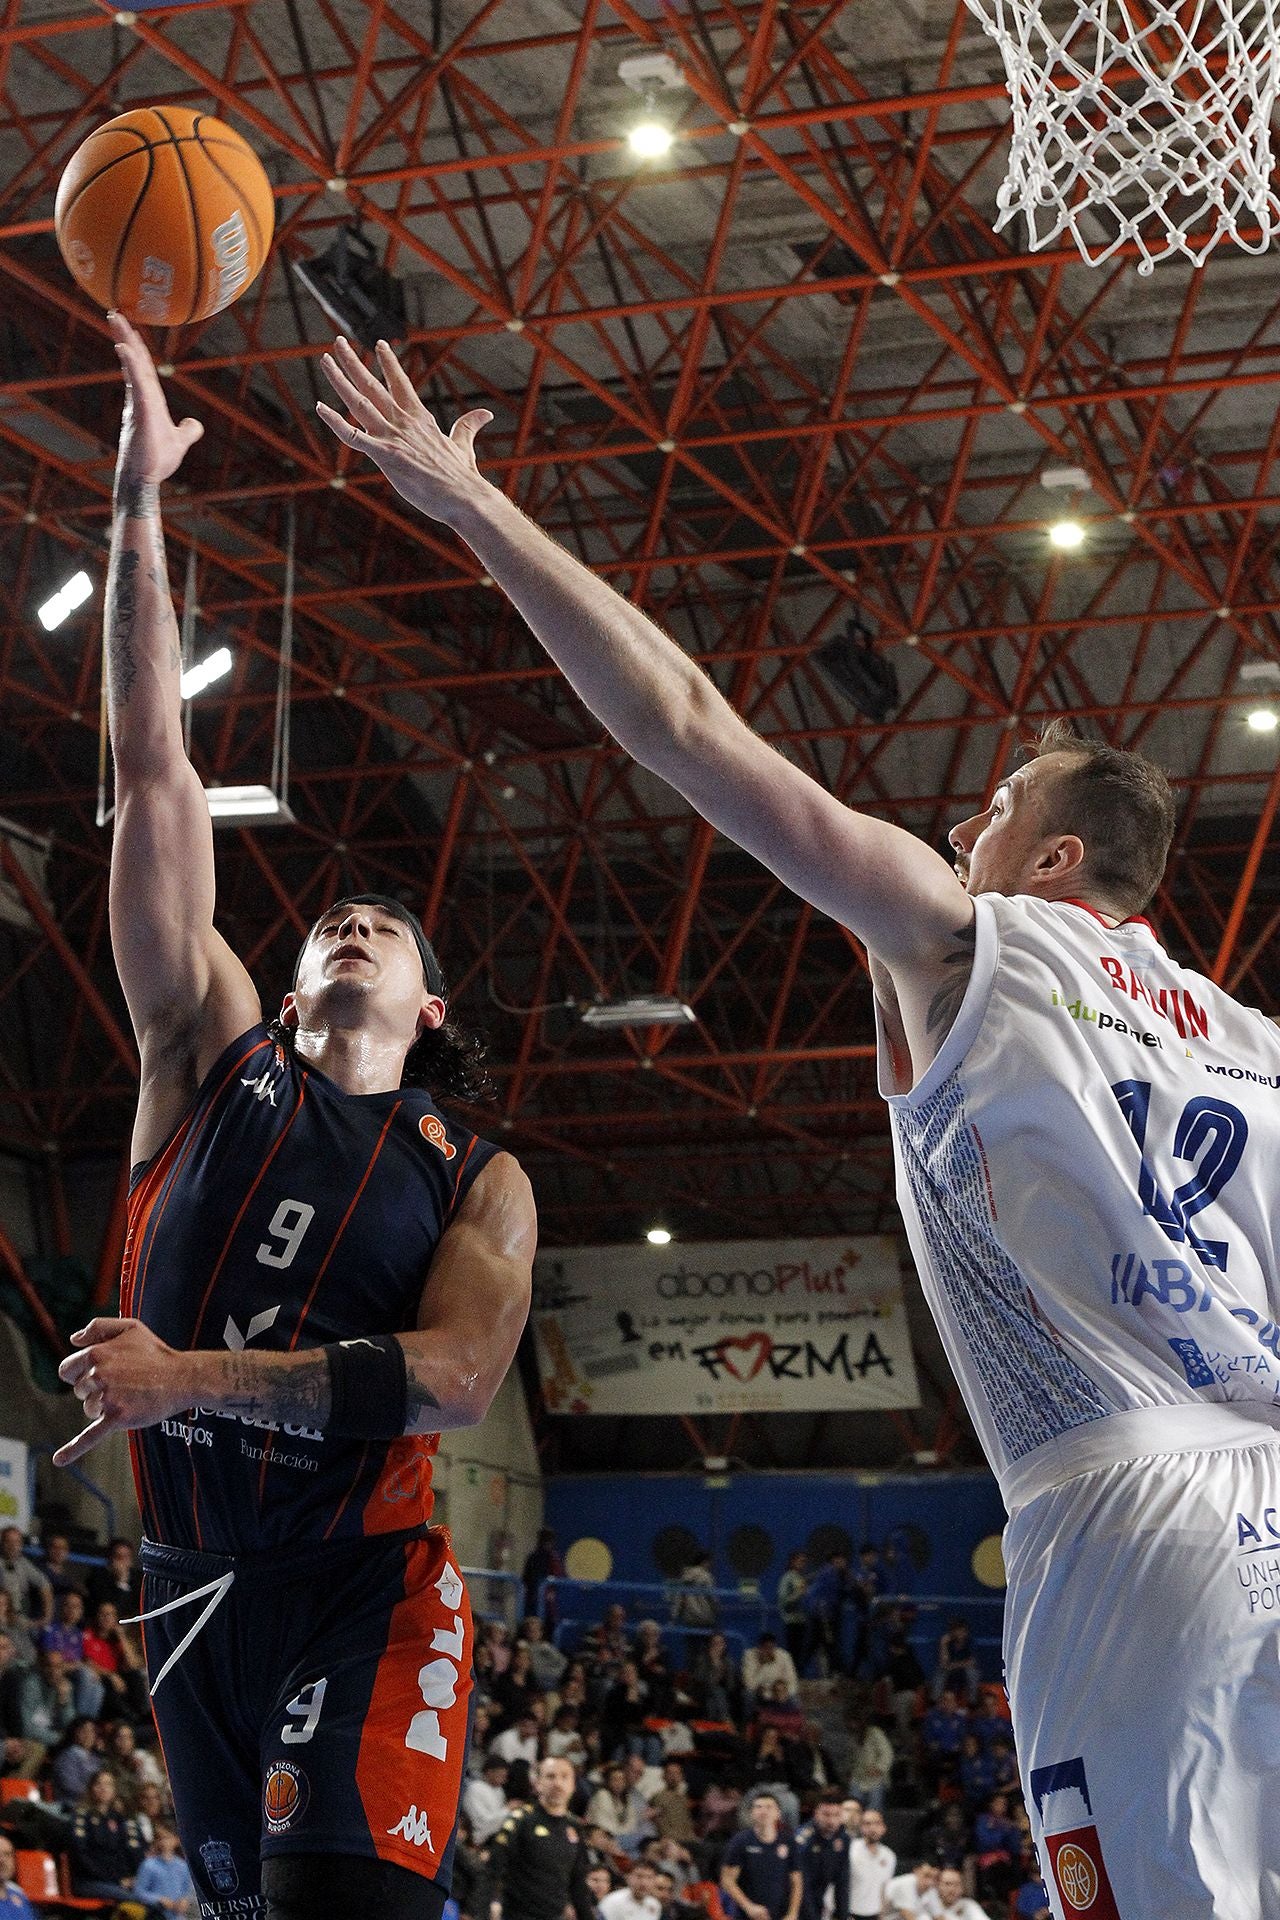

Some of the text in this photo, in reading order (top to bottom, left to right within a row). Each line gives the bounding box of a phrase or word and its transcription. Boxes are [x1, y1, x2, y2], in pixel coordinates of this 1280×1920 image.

[1052, 989, 1163, 1049] idupanel
[1111, 1078, 1249, 1272] 12
[256, 1199, 316, 1270] 9
[240, 1438, 319, 1472] Fundación
[1249, 1584, 1280, 1613] PO
[281, 1677, 328, 1744] 9
